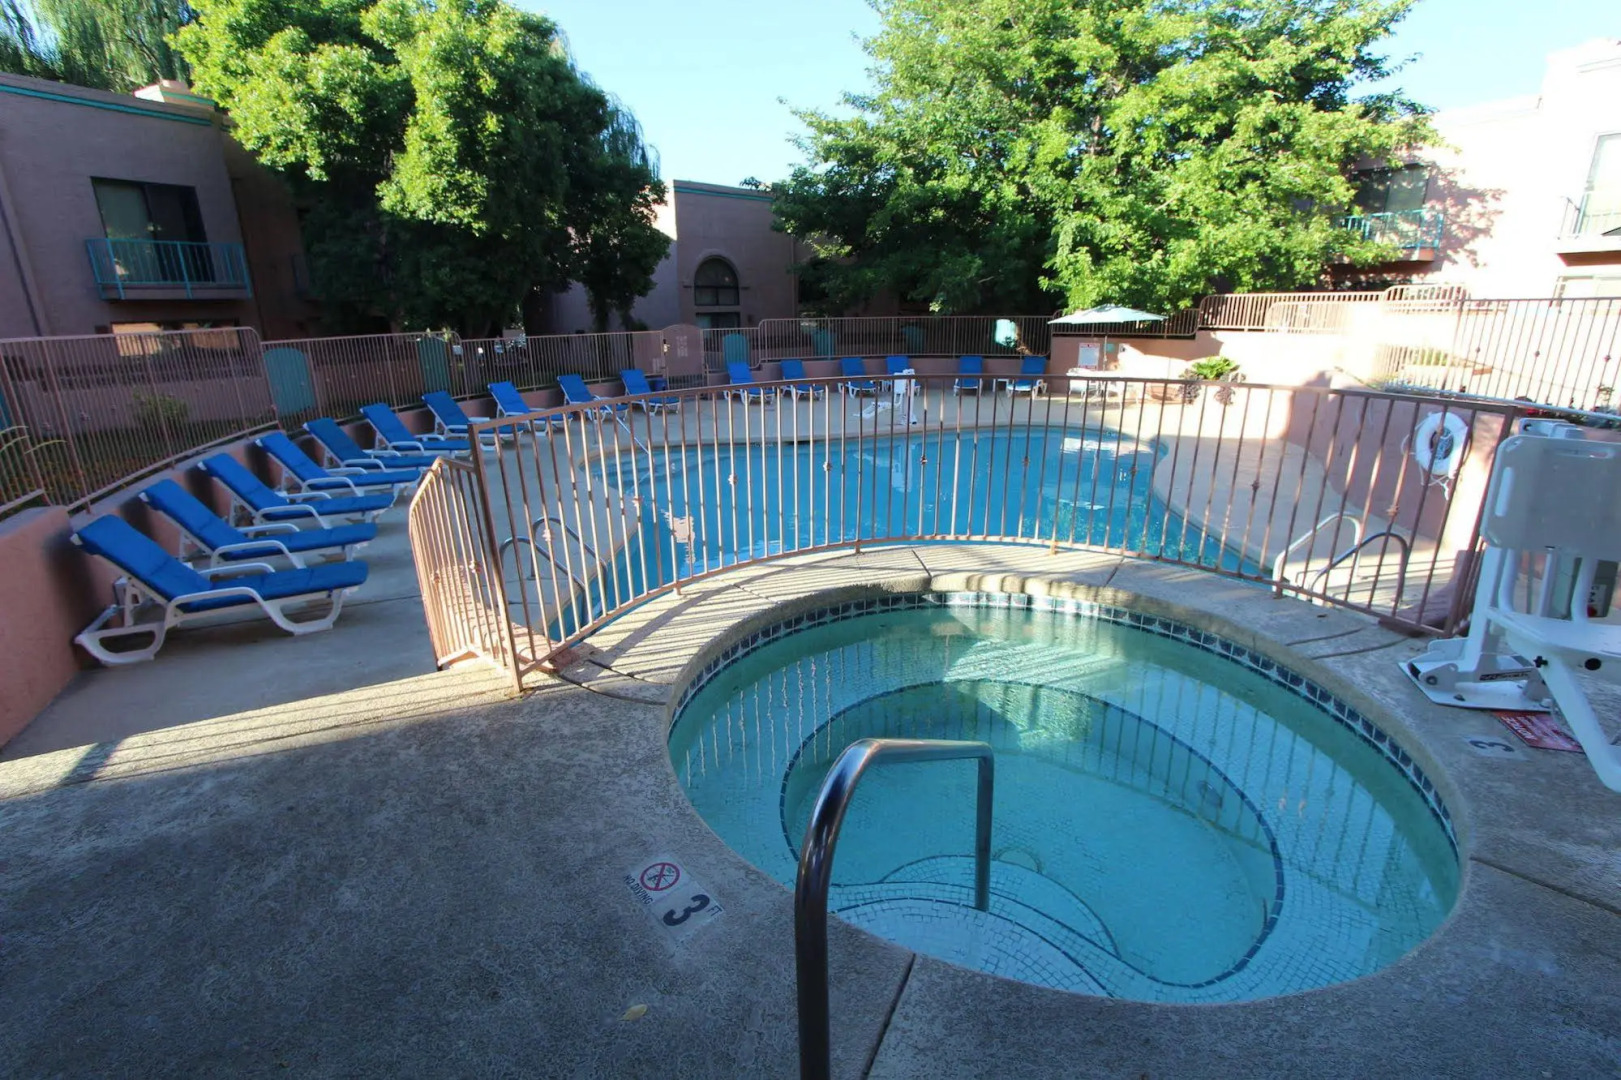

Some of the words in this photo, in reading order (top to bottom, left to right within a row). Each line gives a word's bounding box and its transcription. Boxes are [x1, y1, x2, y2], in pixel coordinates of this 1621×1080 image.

[1469, 740, 1515, 753] 3
[623, 874, 635, 886] NO
[631, 883, 653, 905] DIVING
[663, 894, 710, 926] 3
[706, 905, 722, 917] FT
